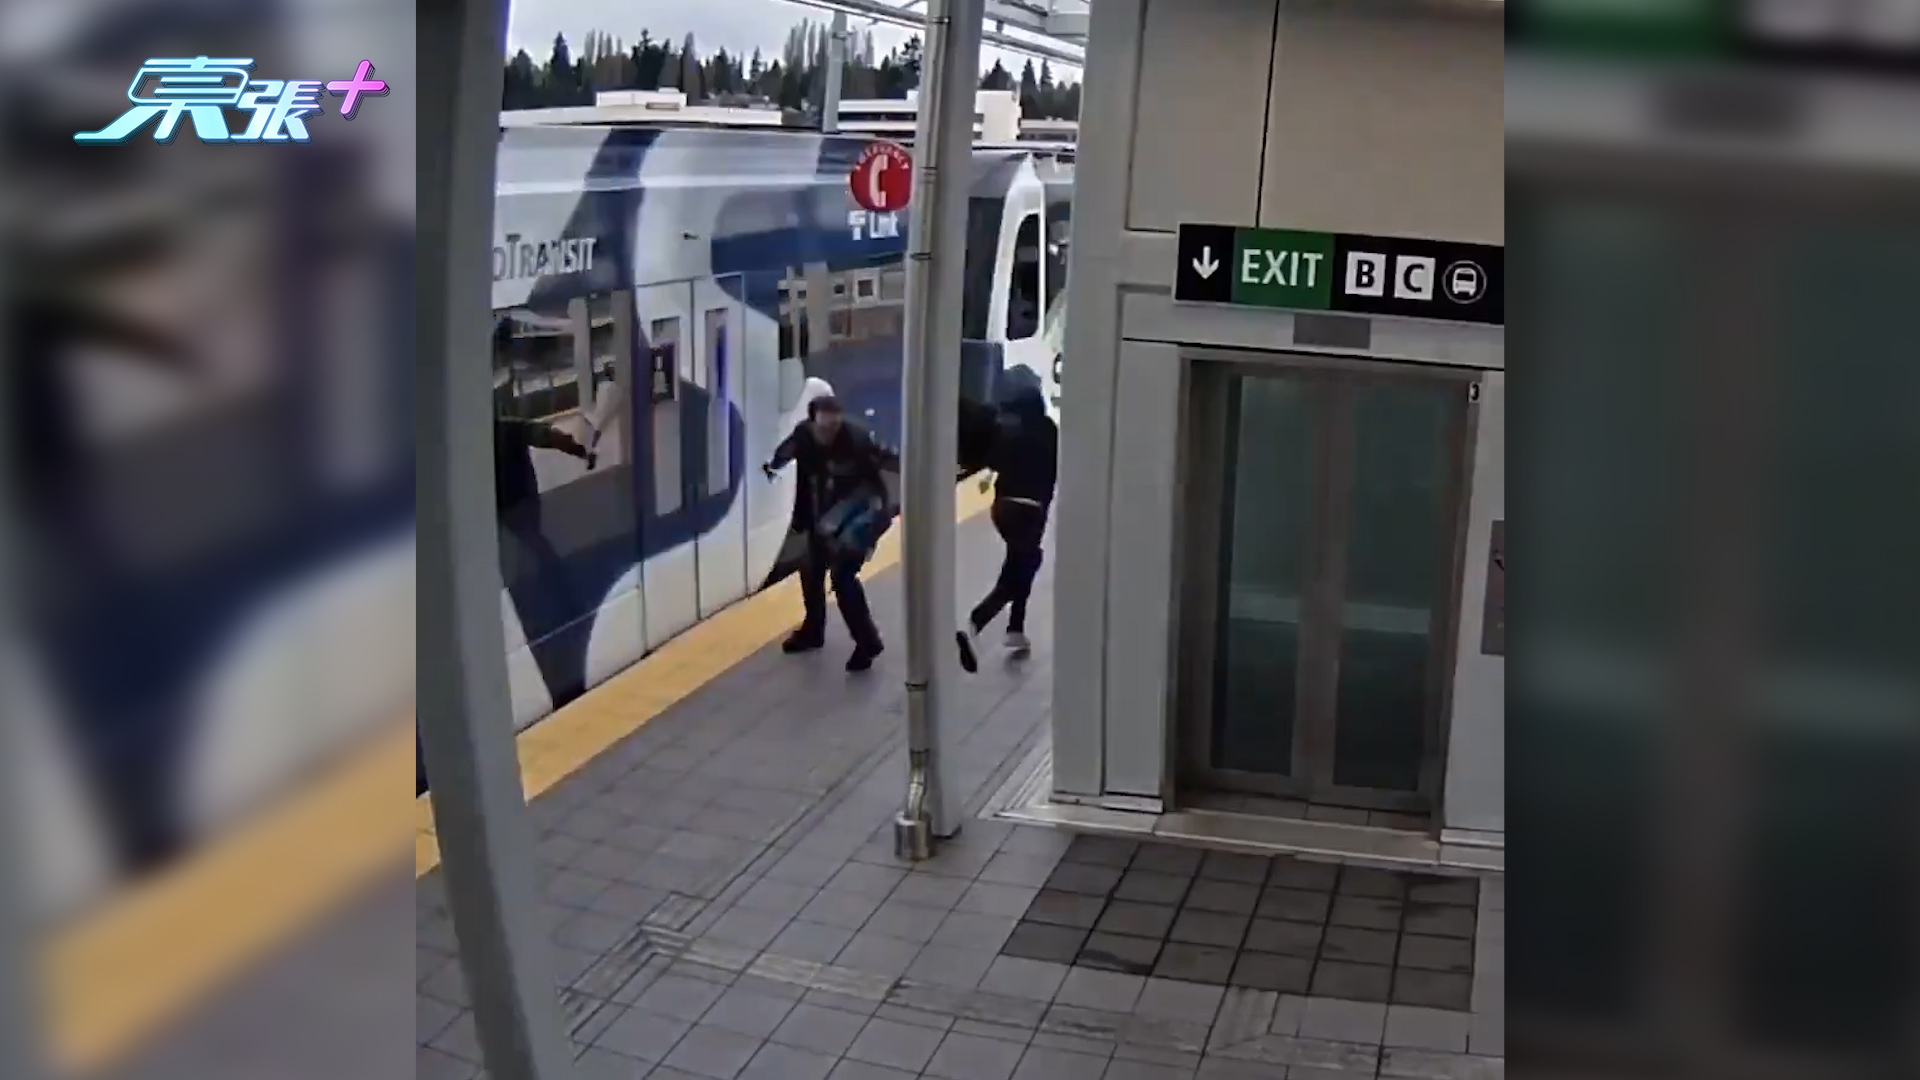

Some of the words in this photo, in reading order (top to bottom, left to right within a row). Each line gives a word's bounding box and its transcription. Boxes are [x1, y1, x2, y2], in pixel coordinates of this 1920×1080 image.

[1241, 248, 1324, 288] EXIT
[1355, 259, 1377, 289] B
[1403, 263, 1426, 293] C
